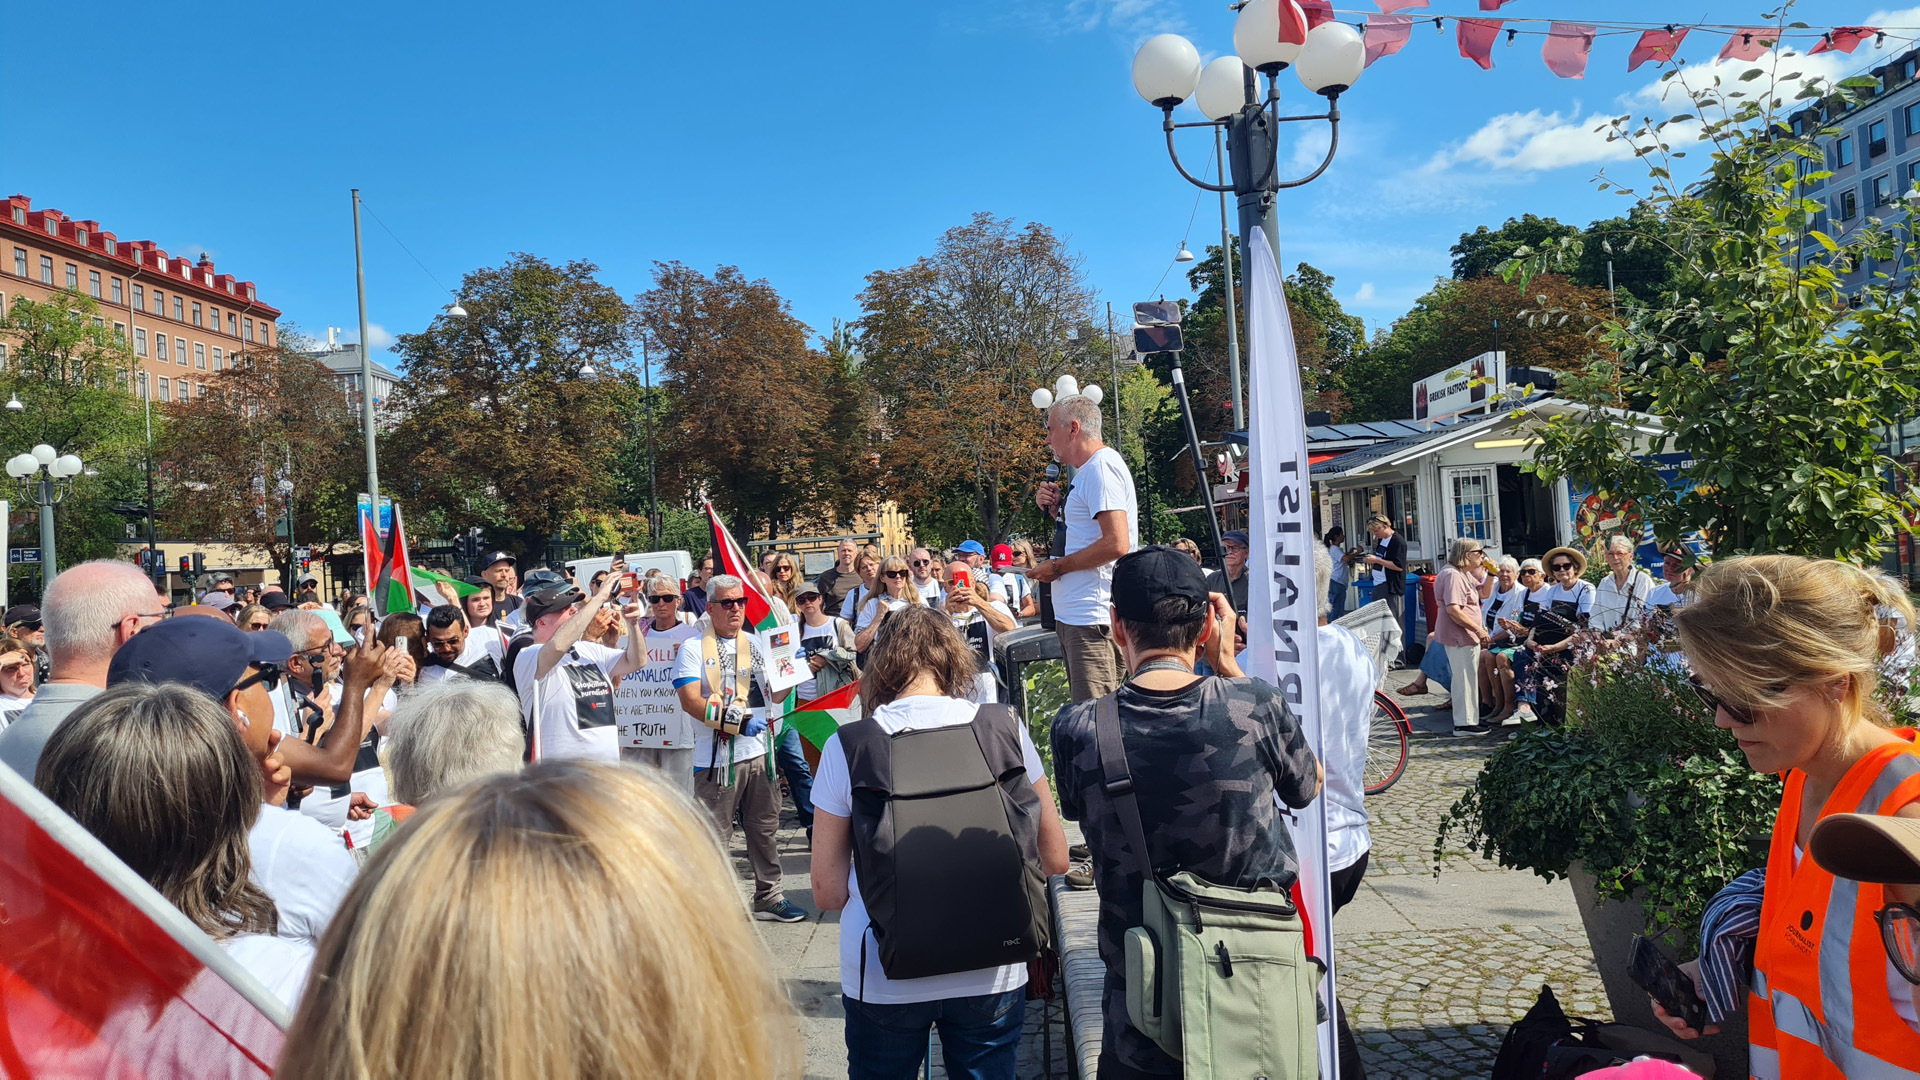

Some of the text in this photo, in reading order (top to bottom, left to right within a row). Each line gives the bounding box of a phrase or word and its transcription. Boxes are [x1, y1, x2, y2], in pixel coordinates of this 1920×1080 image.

[1429, 380, 1469, 402] GREKISK FASTFOOD
[575, 681, 590, 689] Stop
[640, 688, 652, 698] YOU
[654, 687, 677, 698] KNOW
[614, 704, 628, 715] HEY
[630, 705, 643, 715] ARE
[643, 703, 675, 715] TELLING
[618, 722, 666, 737] HE TRUTH
[1786, 924, 1815, 950] JOURNALIST
